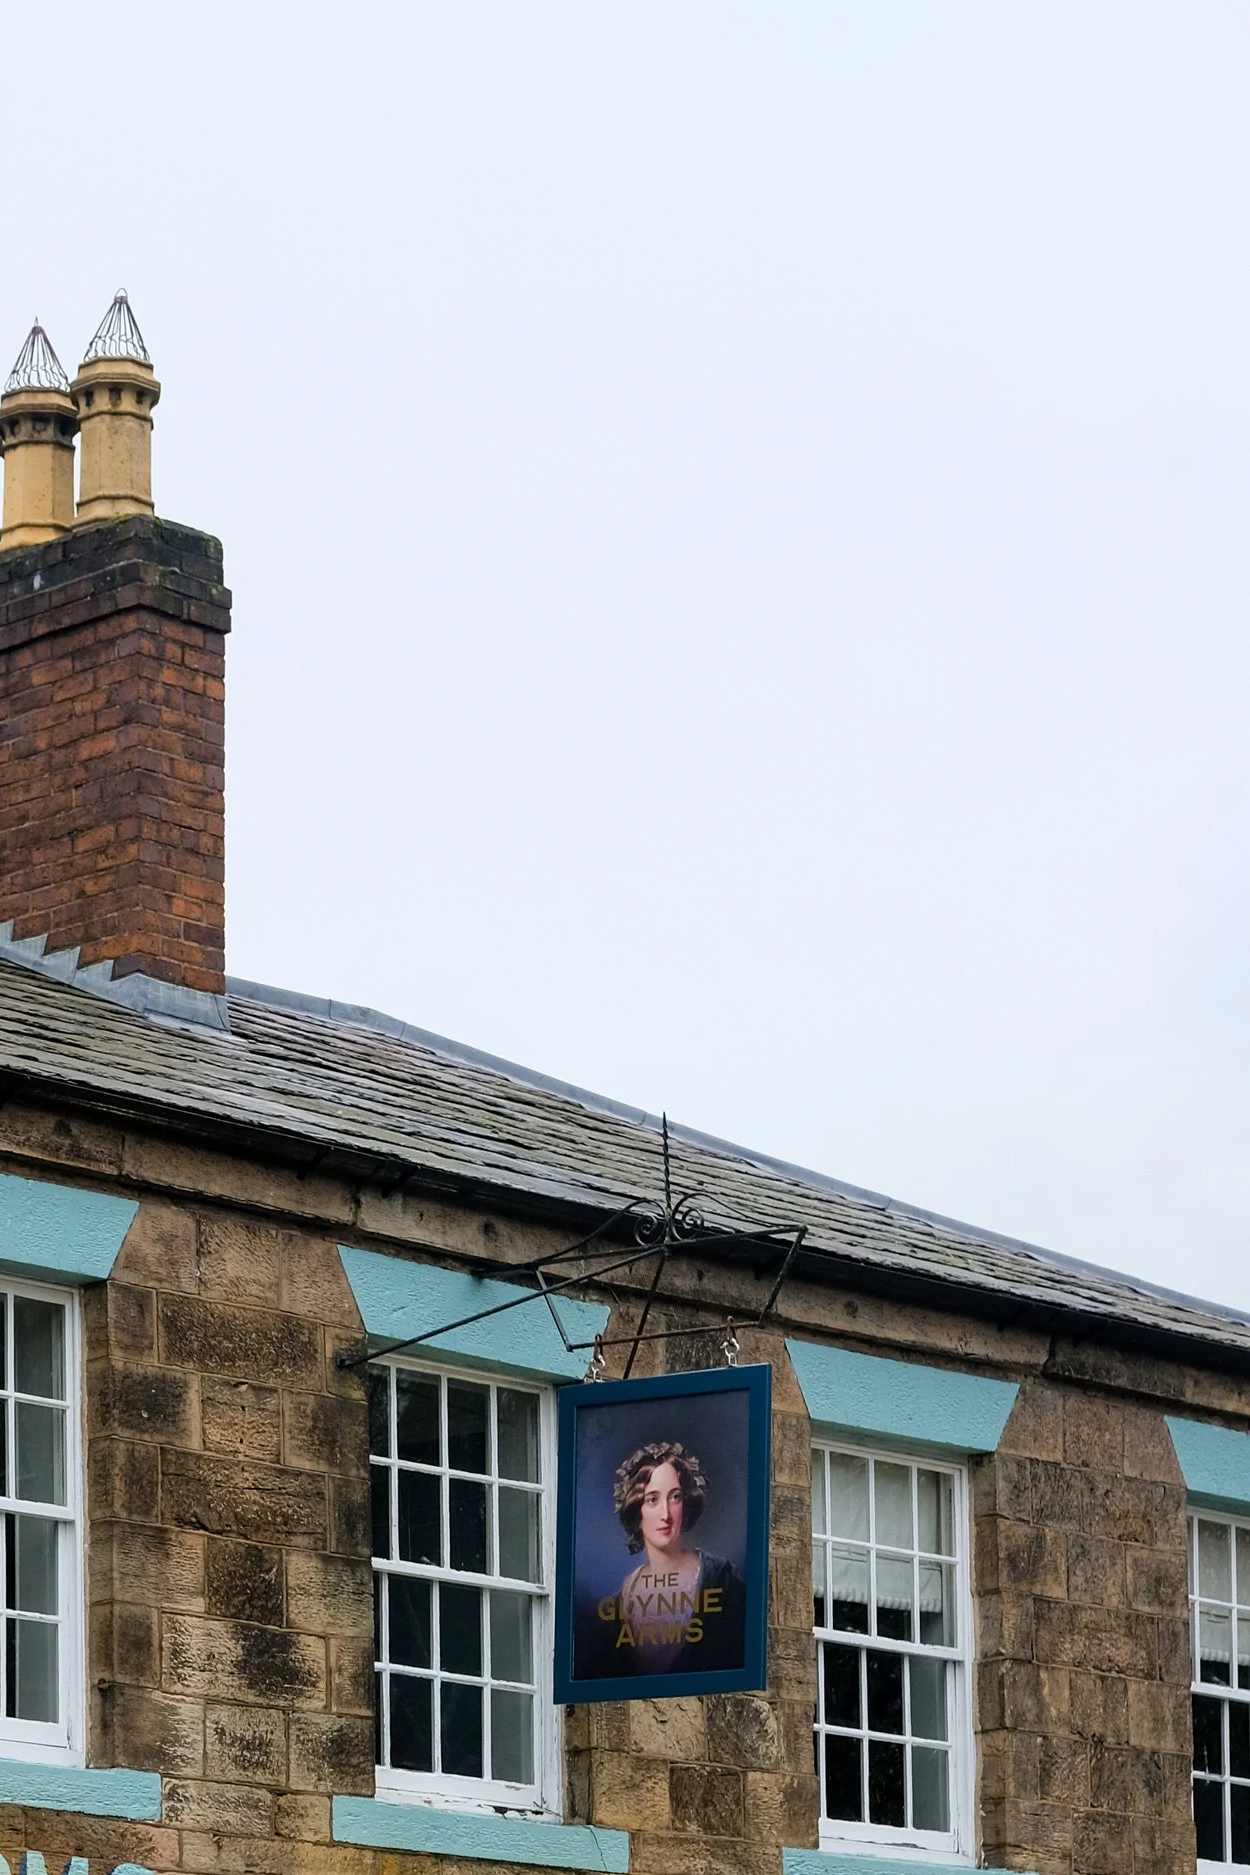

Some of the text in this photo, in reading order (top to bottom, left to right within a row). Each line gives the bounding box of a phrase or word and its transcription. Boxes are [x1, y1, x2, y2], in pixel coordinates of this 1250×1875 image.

[641, 1572, 680, 1589] THE
[597, 1587, 723, 1622] GLYNNE
[615, 1617, 704, 1649] ARMS
